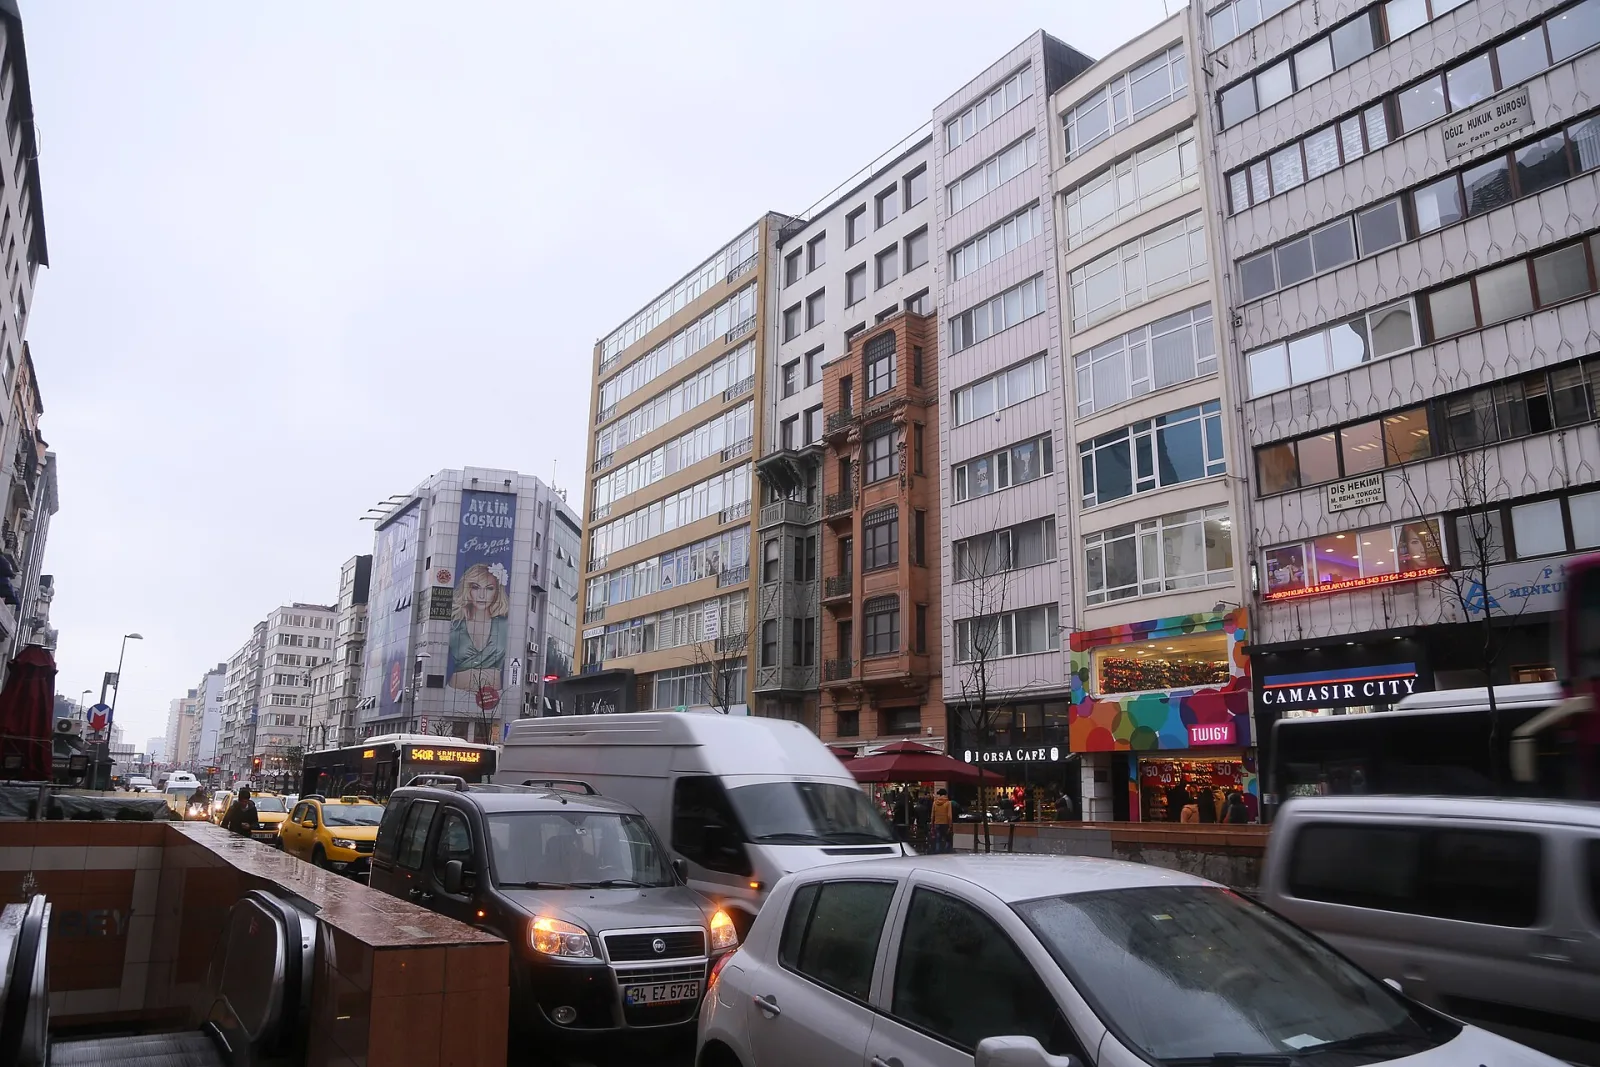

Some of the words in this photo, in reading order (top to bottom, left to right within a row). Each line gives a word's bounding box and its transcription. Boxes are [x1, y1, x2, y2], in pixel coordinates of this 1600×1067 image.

[1444, 124, 1464, 141] OĞUZ
[1467, 111, 1493, 131] HUKUK
[1496, 95, 1527, 117] BÜROSU
[1470, 131, 1490, 143] Fatih
[1331, 484, 1346, 495] DİŞ
[1347, 475, 1380, 491] HEKİMİ
[1338, 493, 1355, 502] REHA
[468, 499, 509, 515] AYLİN
[462, 512, 513, 529] COŞKUN
[1262, 684, 1356, 704] CAMASIR
[1363, 678, 1416, 697] CITY
[1191, 726, 1229, 742] TWIGY
[1016, 748, 1046, 761] CAFE
[633, 987, 647, 1002] 34
[652, 985, 666, 1001] EZ
[670, 983, 696, 999] 6726
